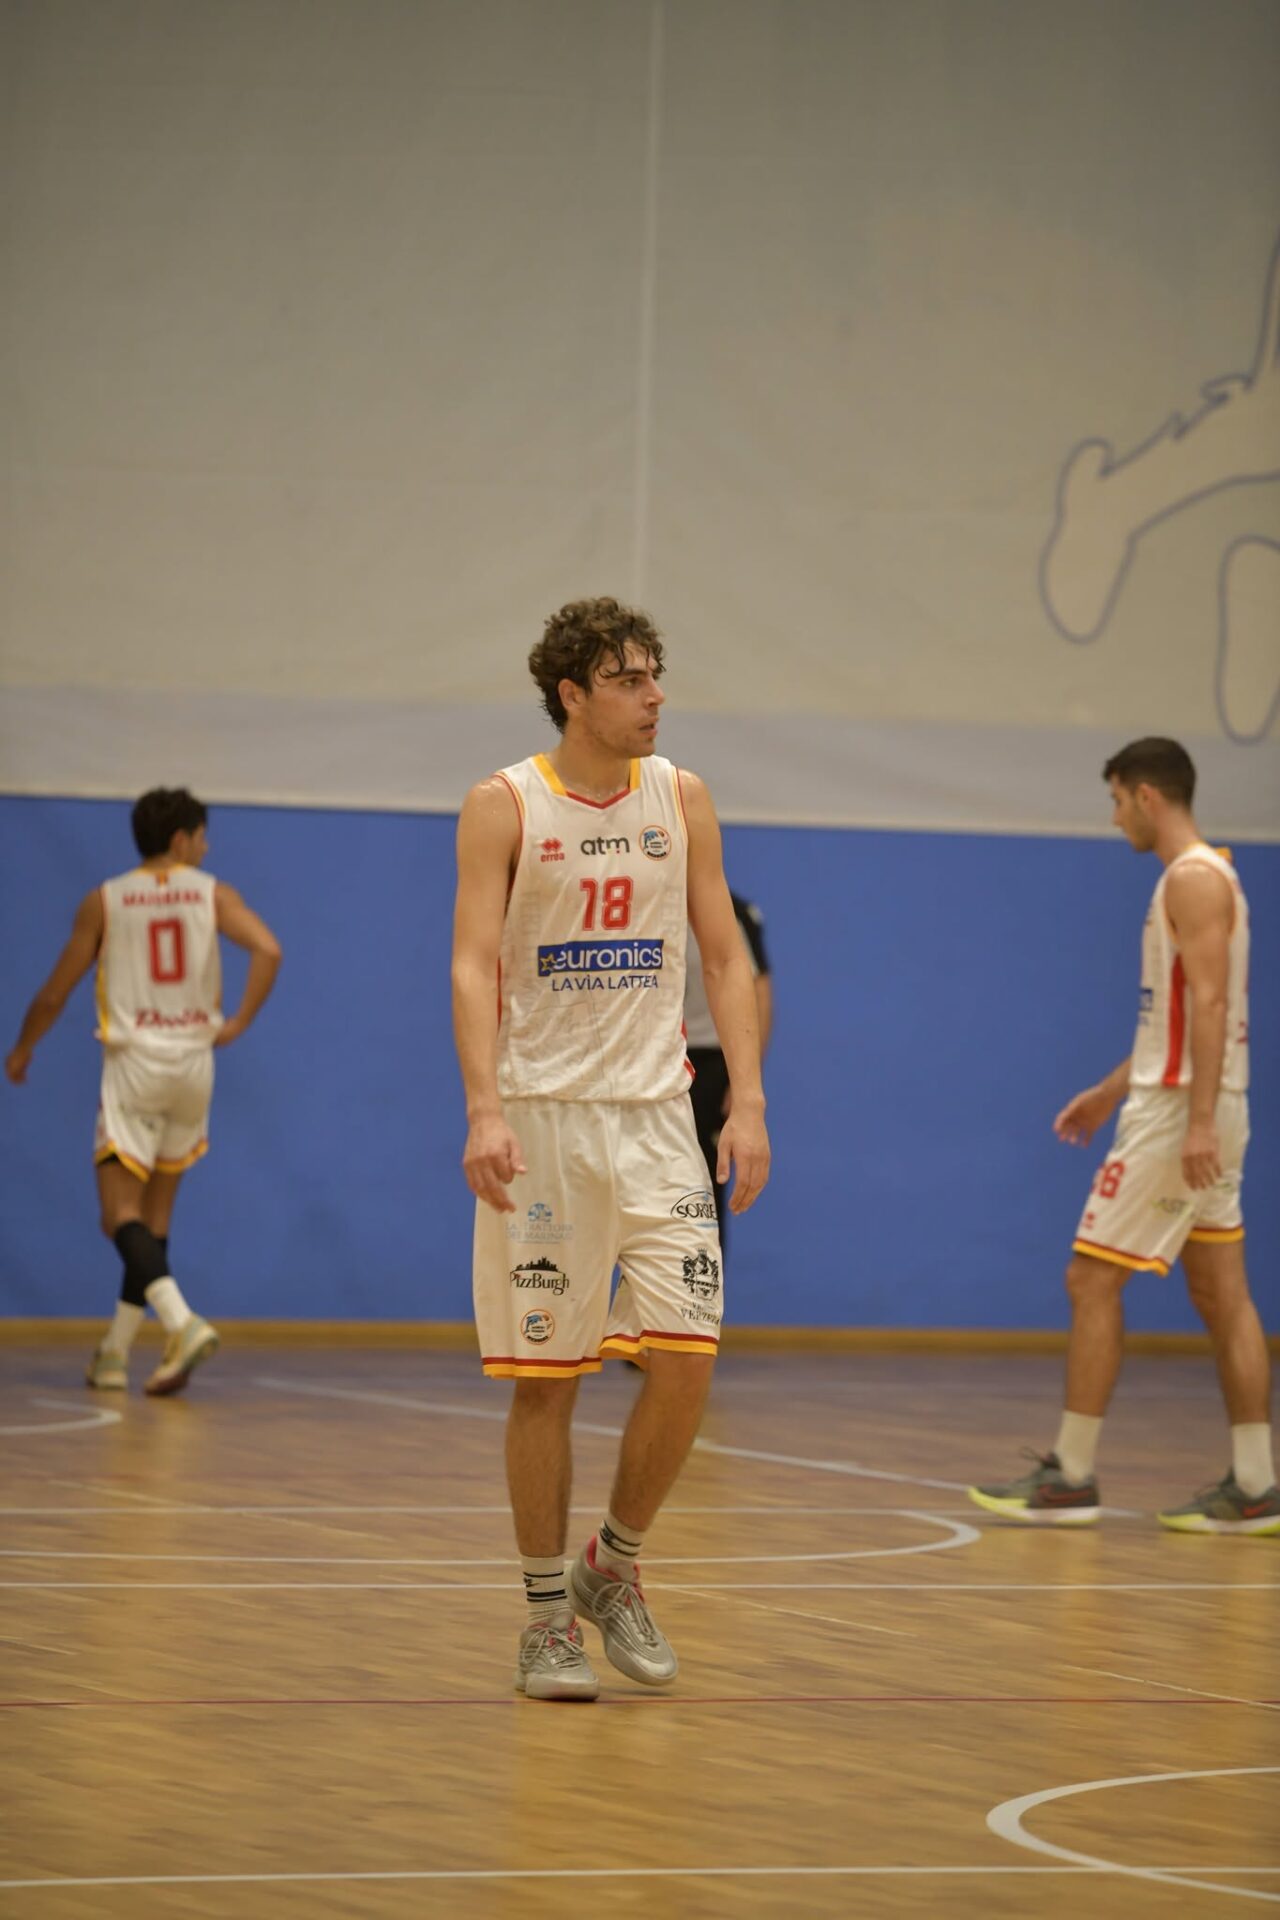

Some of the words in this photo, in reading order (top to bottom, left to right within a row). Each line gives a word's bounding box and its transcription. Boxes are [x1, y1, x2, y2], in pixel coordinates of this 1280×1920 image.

[581, 837, 631, 855] atm
[580, 875, 634, 931] 18
[147, 916, 186, 984] 0
[552, 942, 662, 970] euronics
[608, 975, 659, 990] LATTEA
[510, 1272, 570, 1296] PizzBurgh
